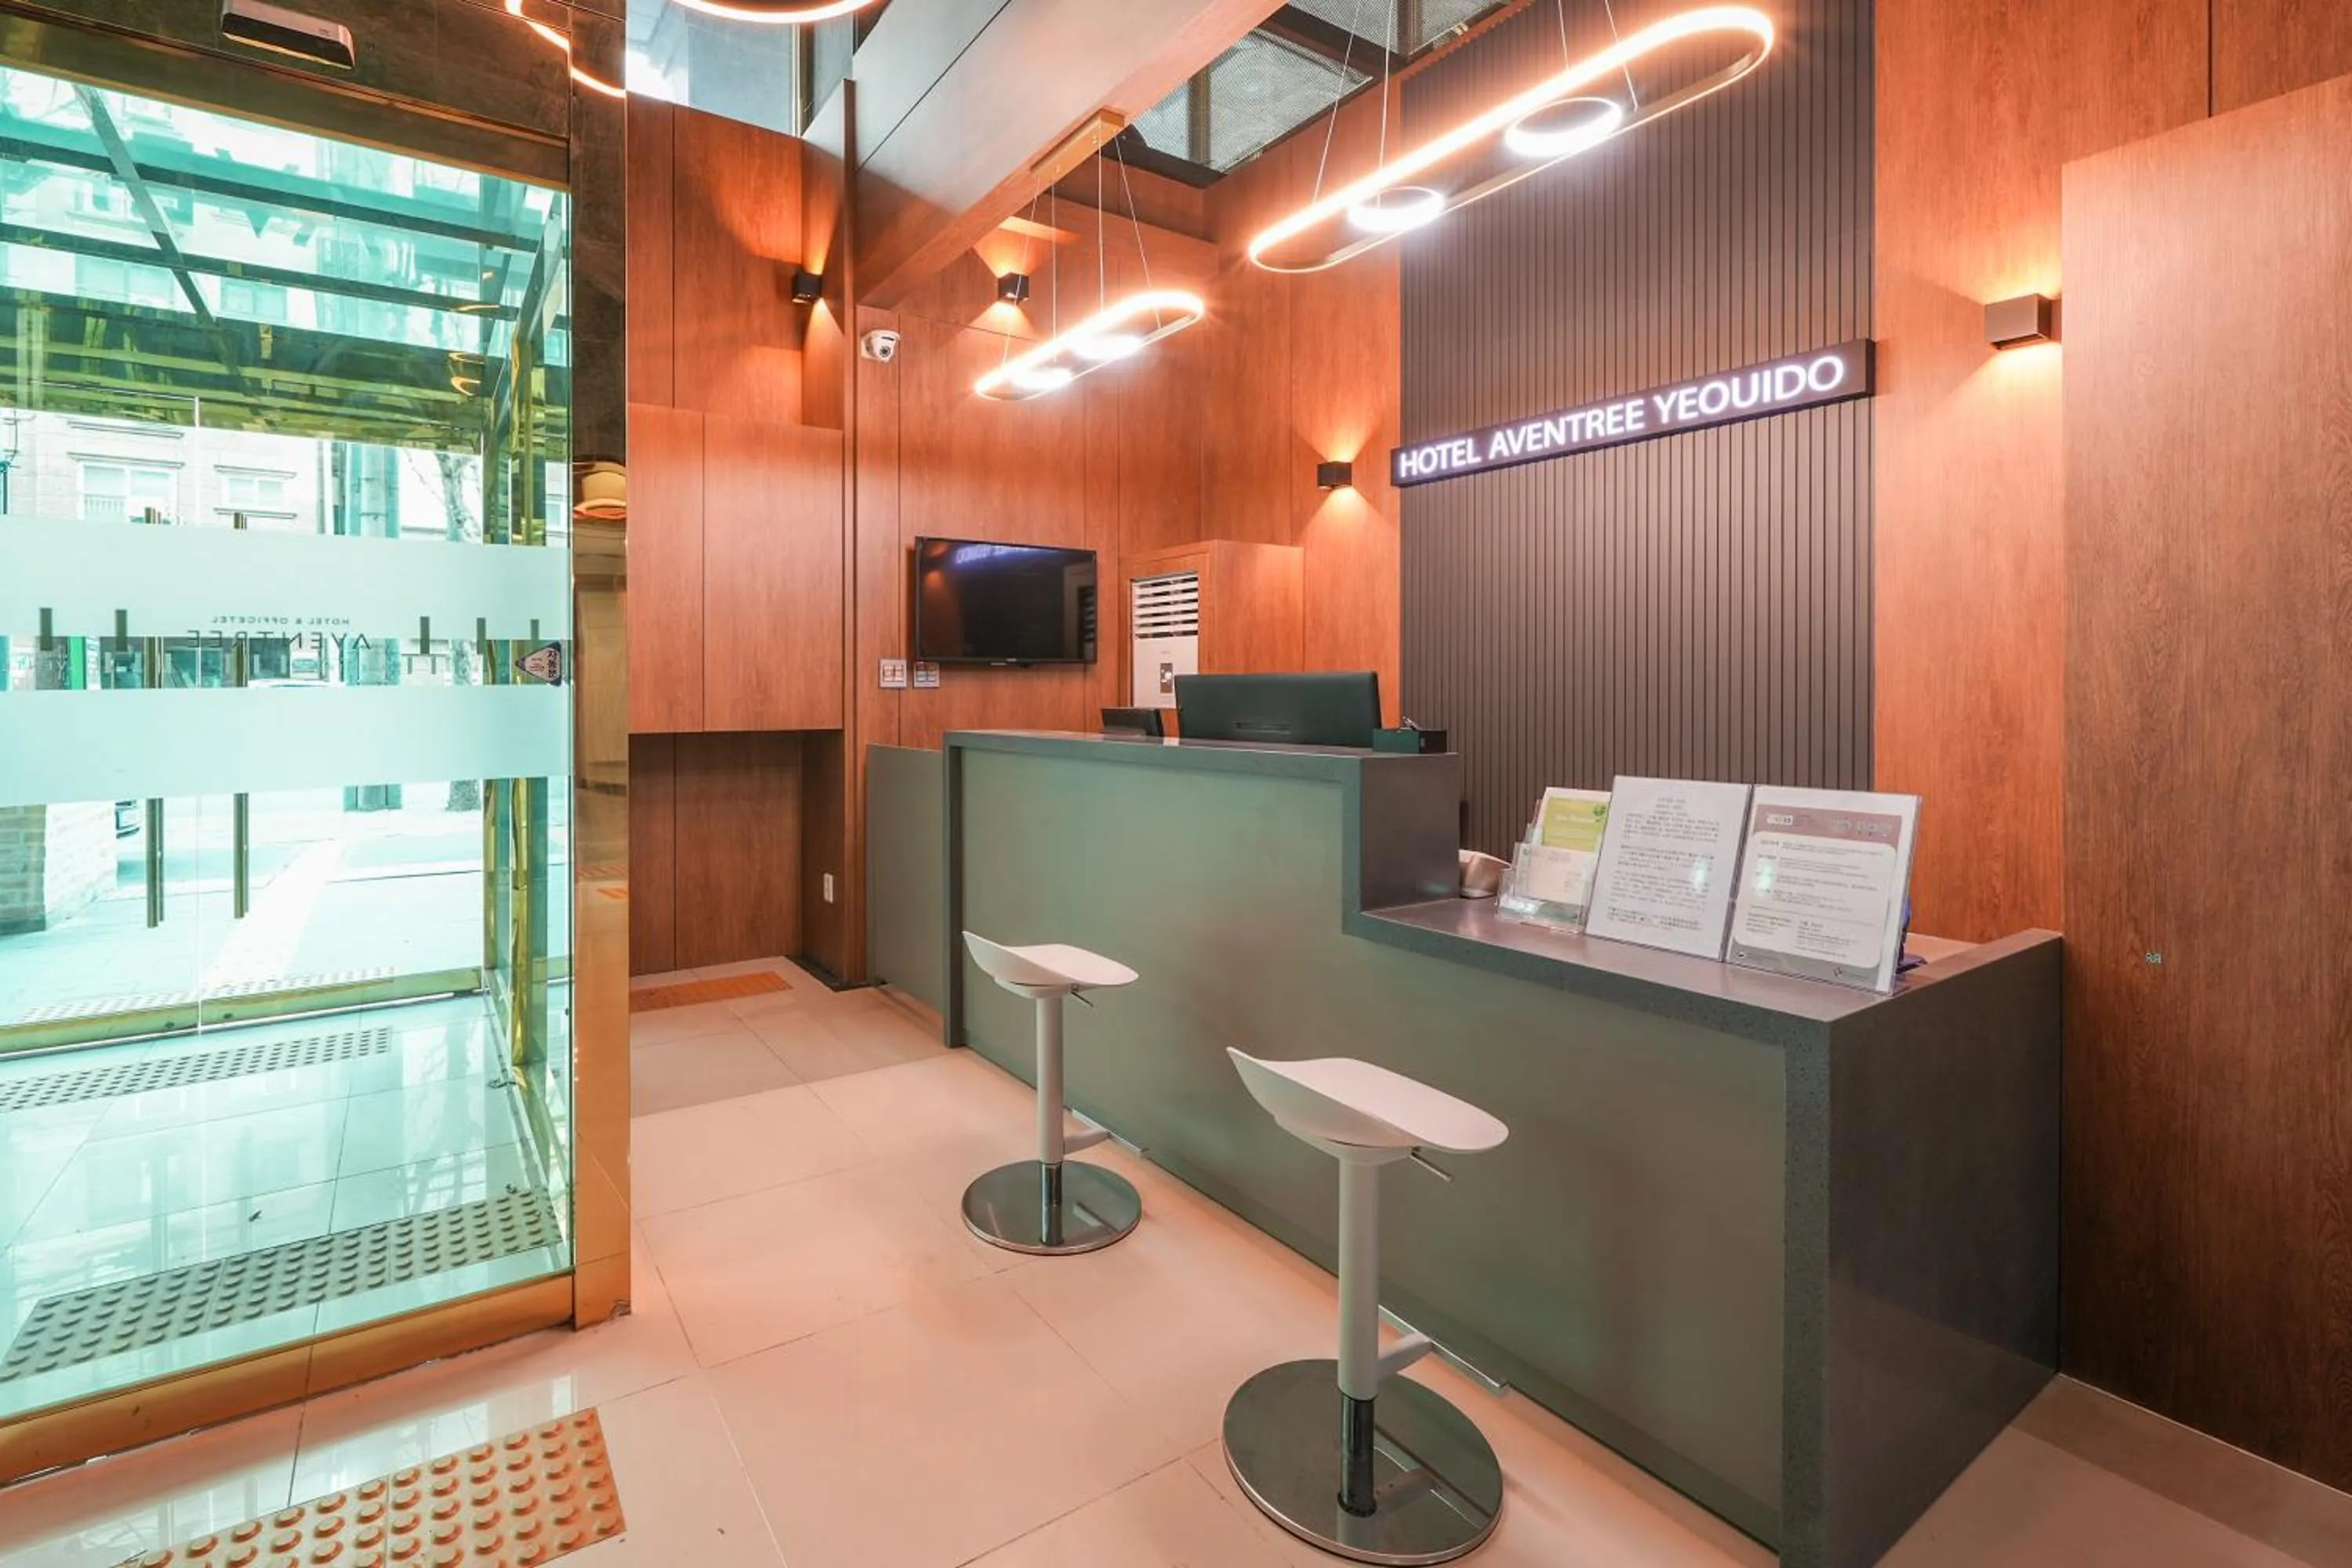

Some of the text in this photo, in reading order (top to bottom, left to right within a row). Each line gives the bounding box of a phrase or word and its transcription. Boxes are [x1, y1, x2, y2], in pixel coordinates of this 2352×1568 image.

[1400, 355, 1844, 477] HOTEL AVENTREE YEOUIDO
